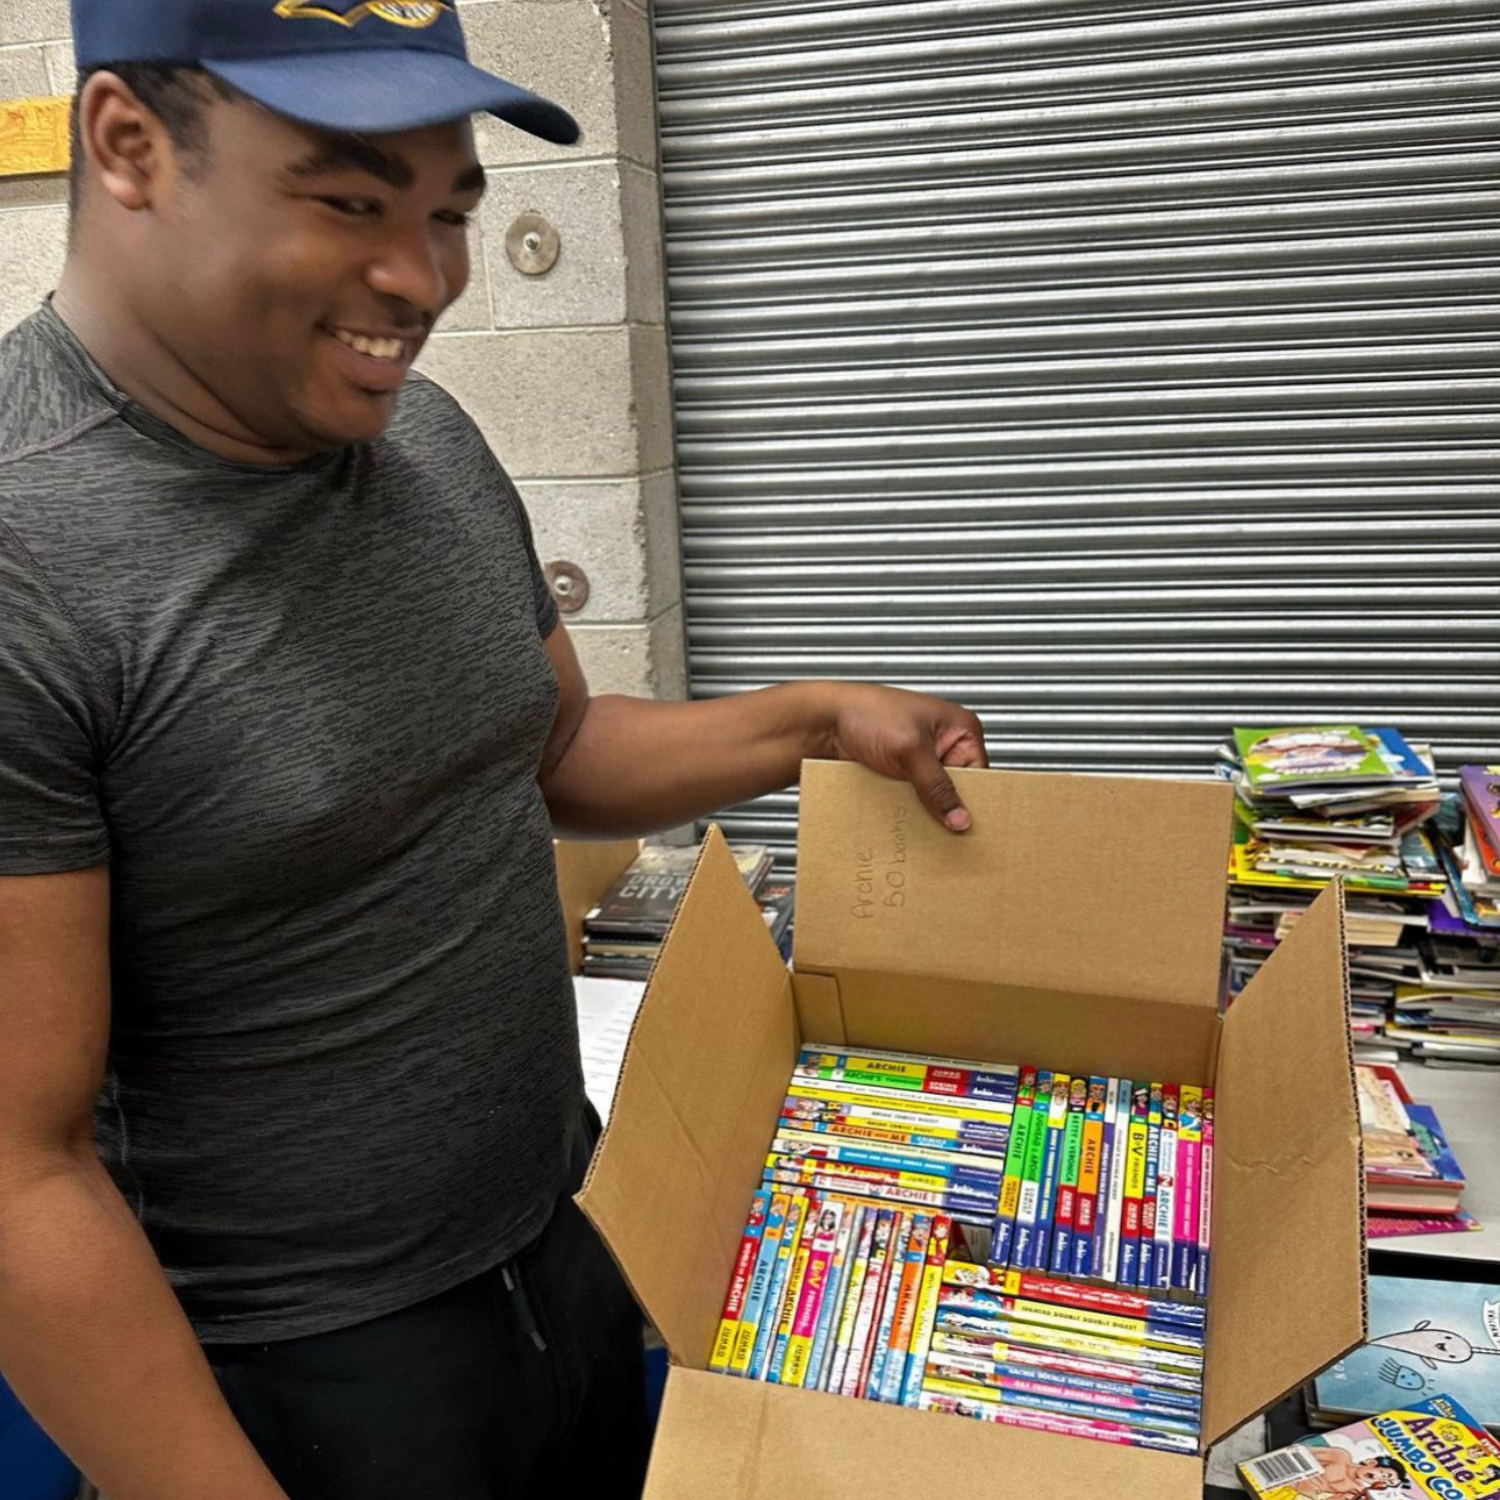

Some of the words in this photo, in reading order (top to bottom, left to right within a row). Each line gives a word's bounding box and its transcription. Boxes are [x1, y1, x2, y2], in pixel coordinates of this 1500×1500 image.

[619, 886, 680, 900] CITY
[851, 847, 875, 918] Archie
[866, 1062, 907, 1073] ARCHIE
[1012, 1123, 1027, 1159] ARCHIE
[1084, 1139, 1097, 1174] ARCHIE
[1157, 1190, 1170, 1228] ARCHIE
[727, 1275, 745, 1312] ARCHIE
[751, 1260, 768, 1302] ARCHIE
[1375, 1417, 1437, 1474] JUMBO
[1404, 1417, 1476, 1483] Archie
